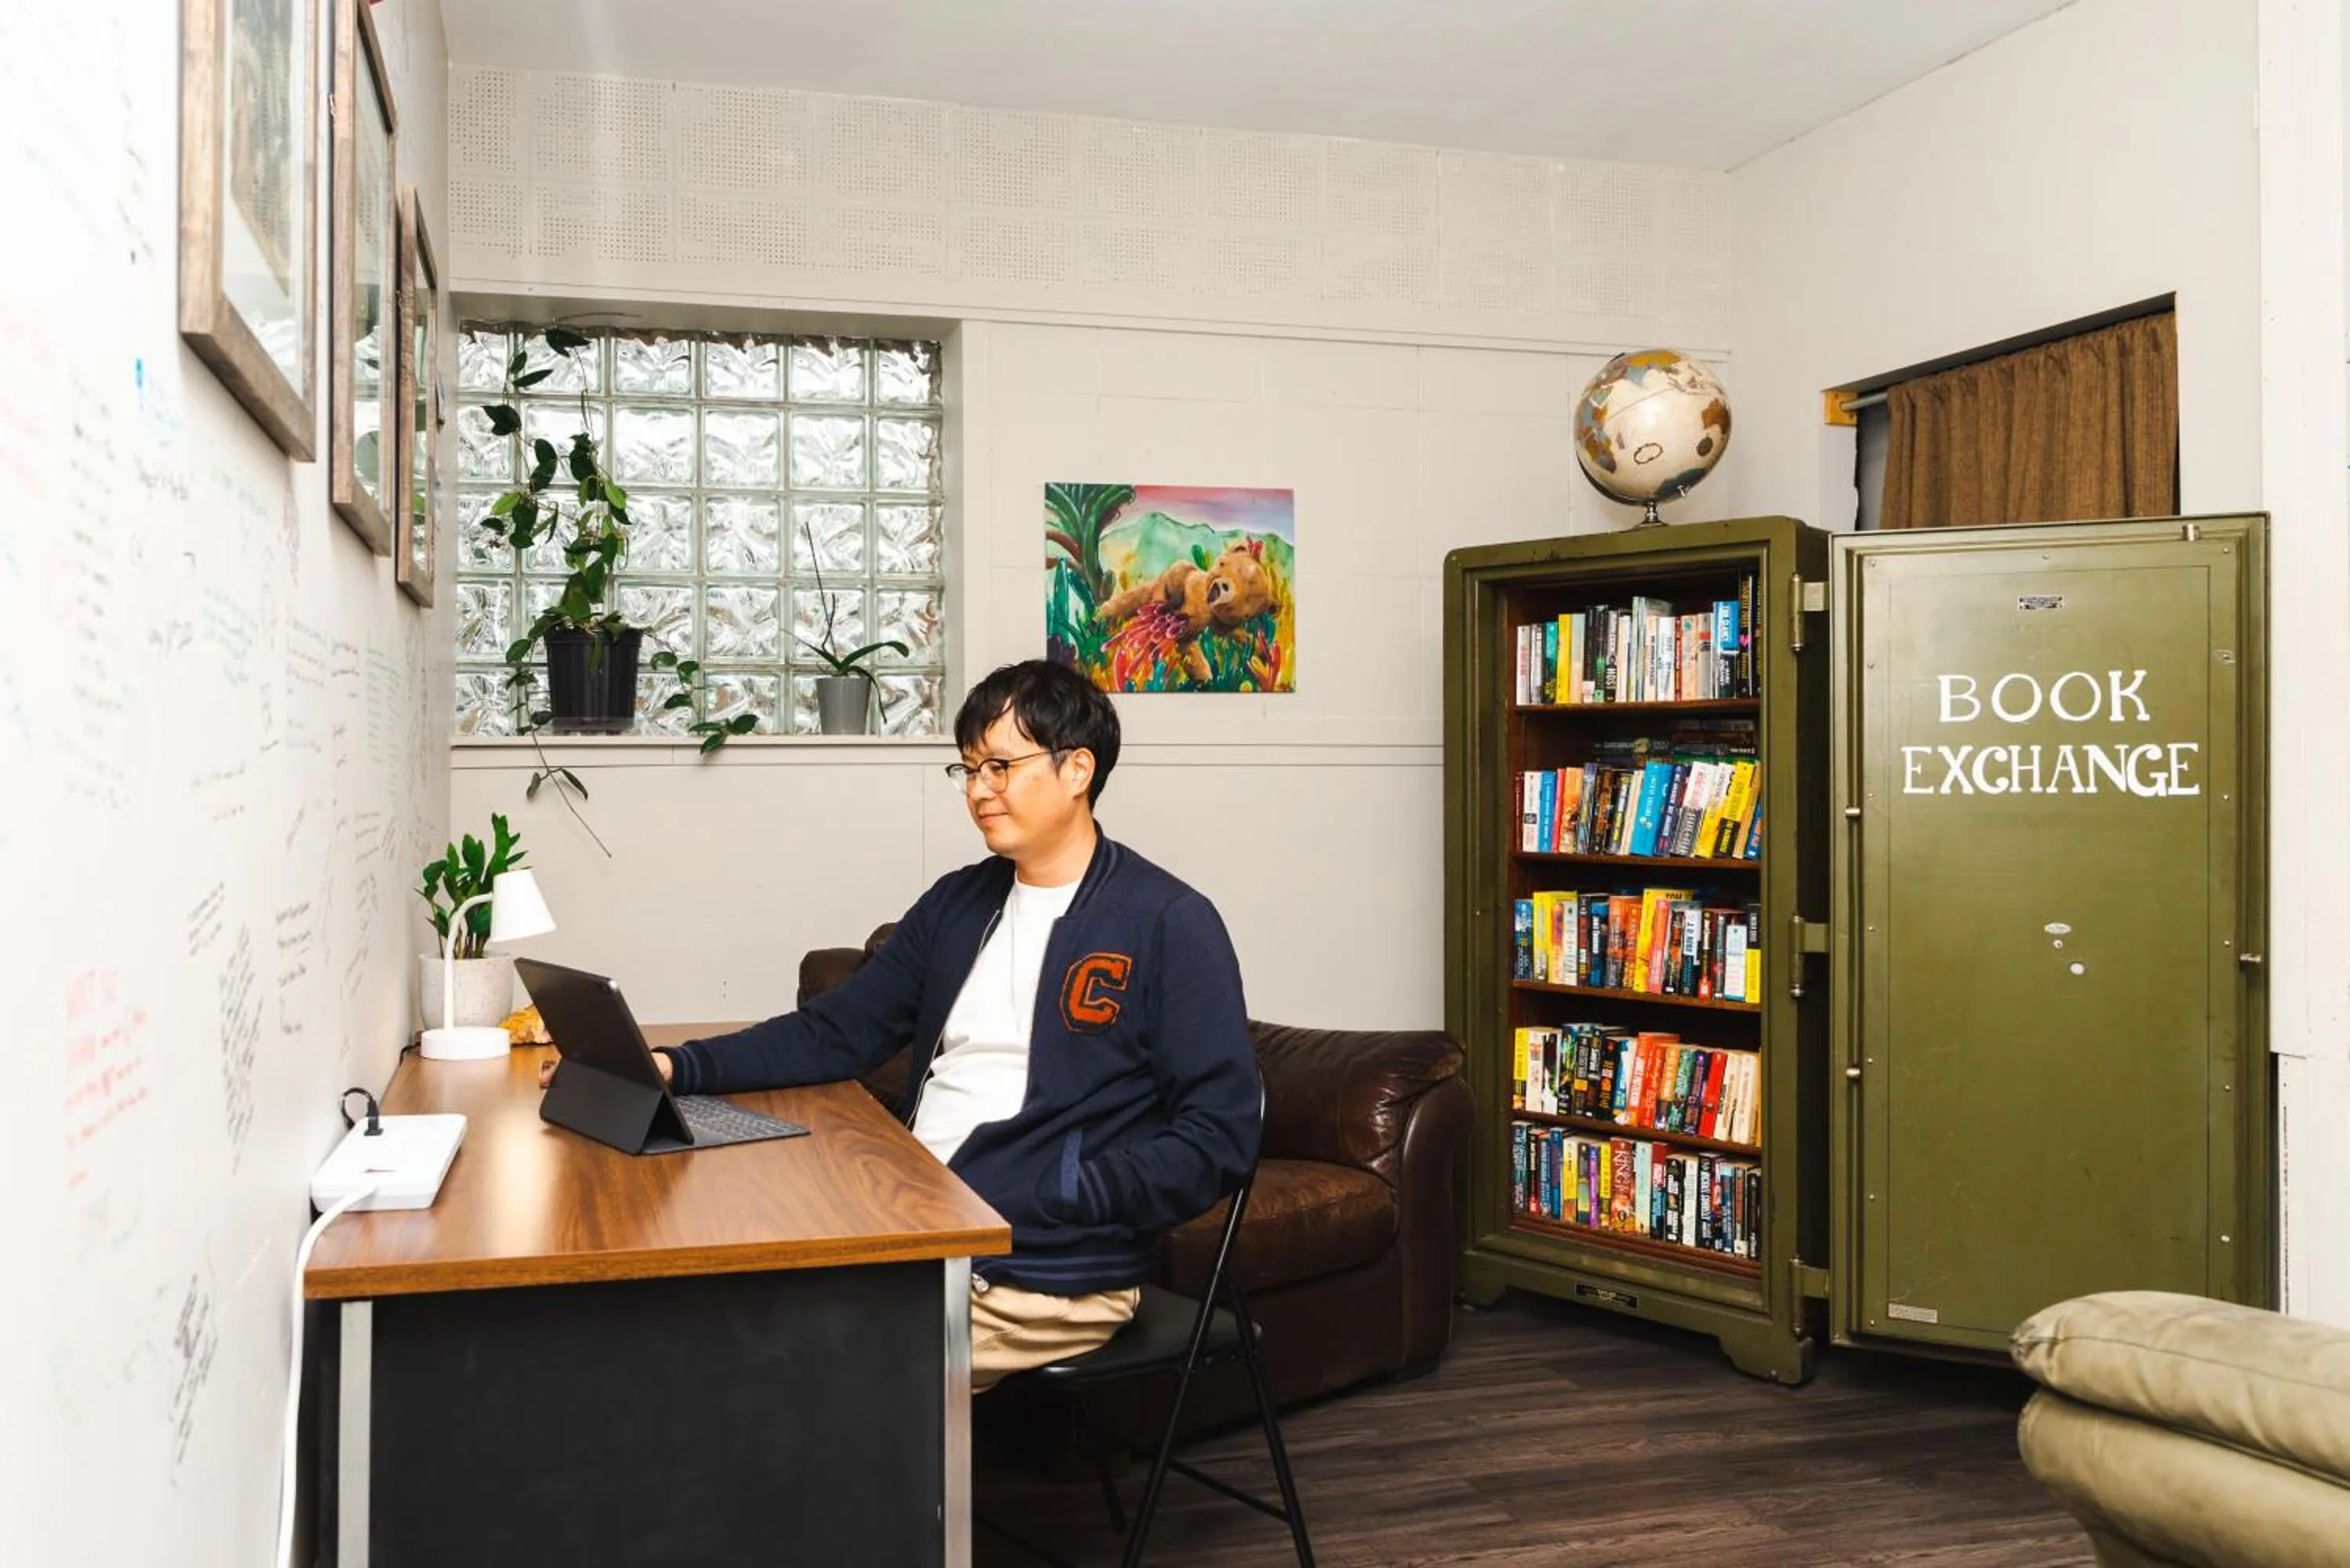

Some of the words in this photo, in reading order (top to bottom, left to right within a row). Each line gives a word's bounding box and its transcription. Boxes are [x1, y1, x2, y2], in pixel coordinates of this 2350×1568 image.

[1938, 670, 2150, 723] BOOK
[1901, 742, 2200, 797] EXCHANGE
[1060, 952, 1132, 1035] C
